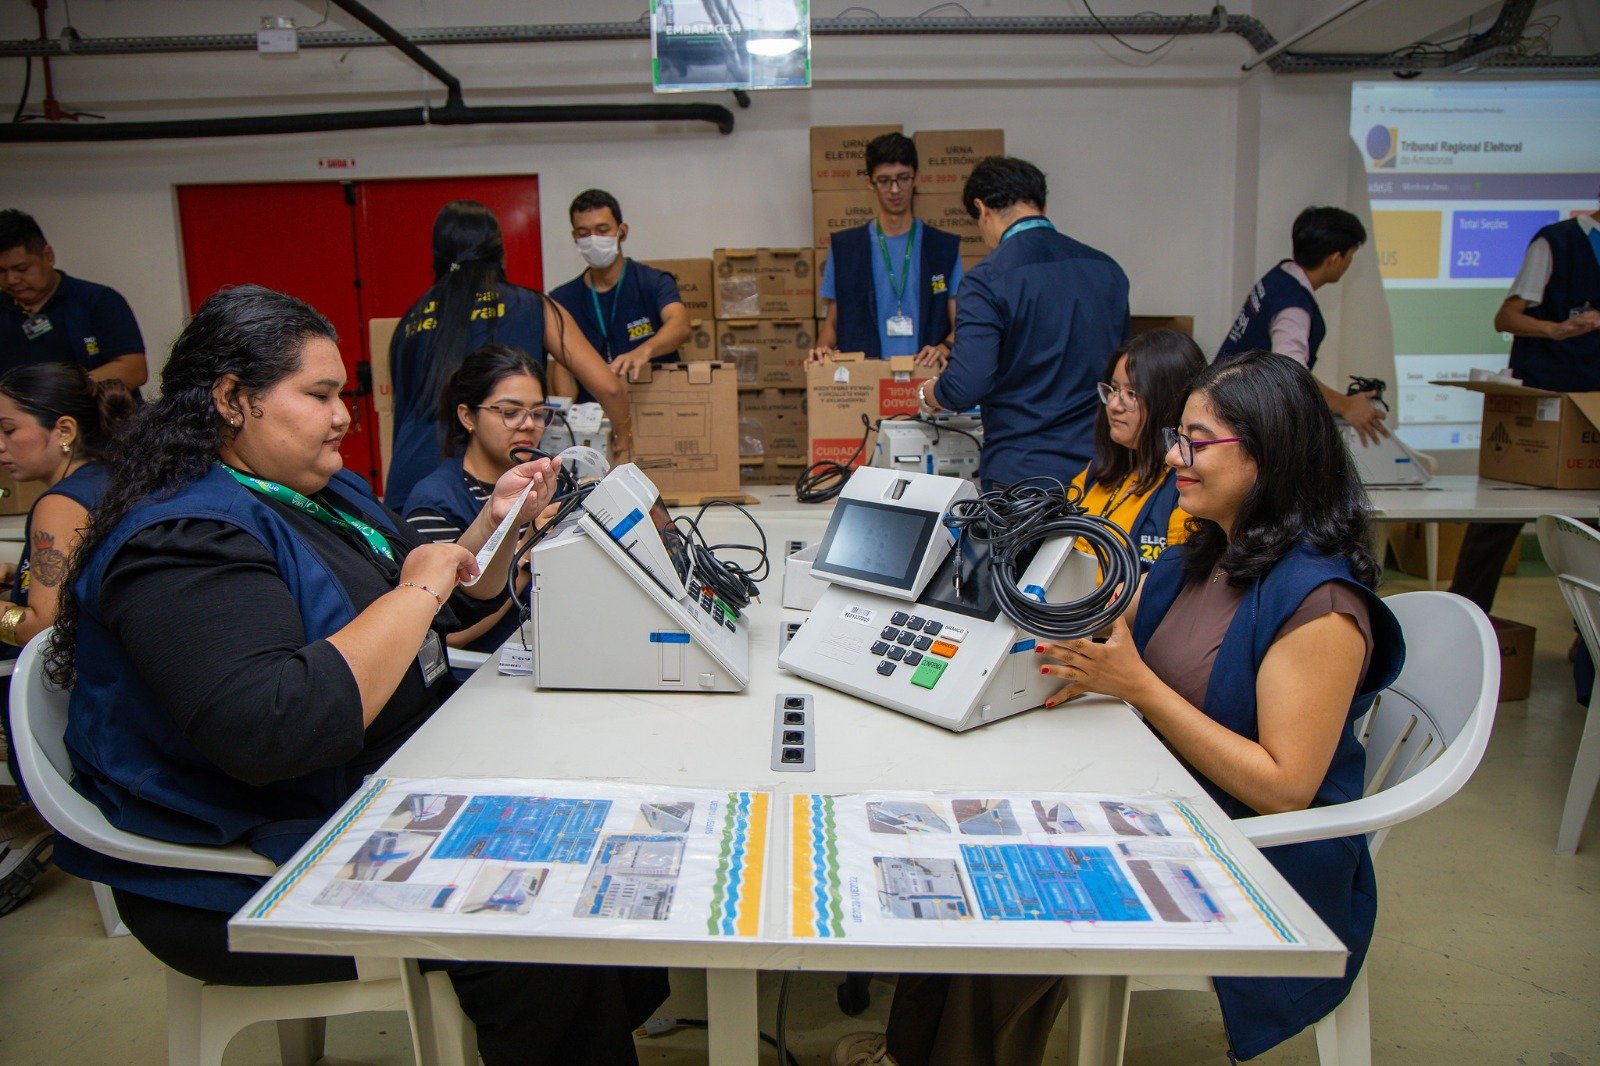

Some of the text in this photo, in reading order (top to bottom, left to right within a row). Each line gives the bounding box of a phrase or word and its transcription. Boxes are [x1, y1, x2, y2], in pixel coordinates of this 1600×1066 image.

[1401, 141, 1523, 154] Tribunal Regional Eleitoral
[845, 207, 874, 216] URNA
[1460, 219, 1509, 231] Total Seções
[1457, 251, 1480, 266] 292
[1567, 459, 1584, 469] UE
[945, 625, 965, 634] BRANCO
